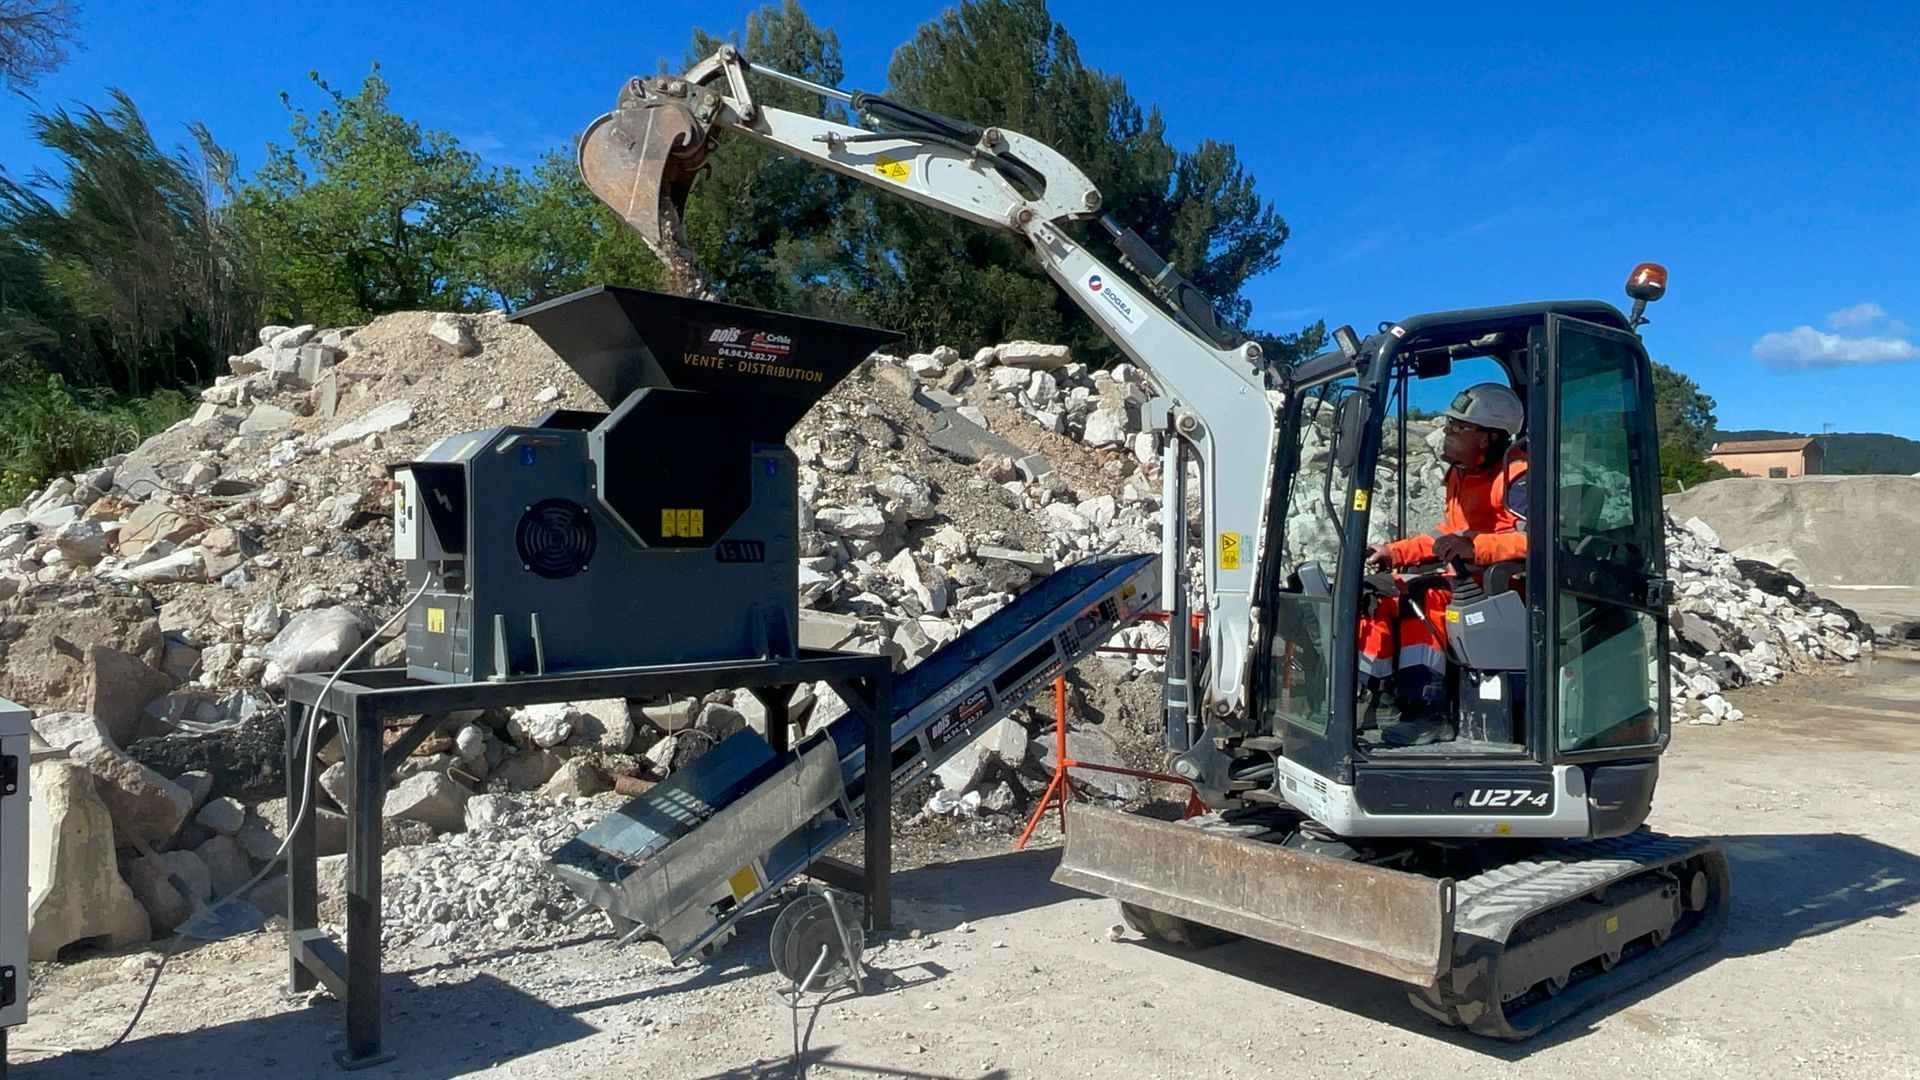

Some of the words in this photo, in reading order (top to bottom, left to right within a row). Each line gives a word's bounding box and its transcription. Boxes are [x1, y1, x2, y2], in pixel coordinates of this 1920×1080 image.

[1104, 288, 1131, 315] SOGEA
[684, 353, 725, 369] VENTE
[738, 361, 823, 382] DISTRIBUTION
[1469, 789, 1549, 807] U27-4
